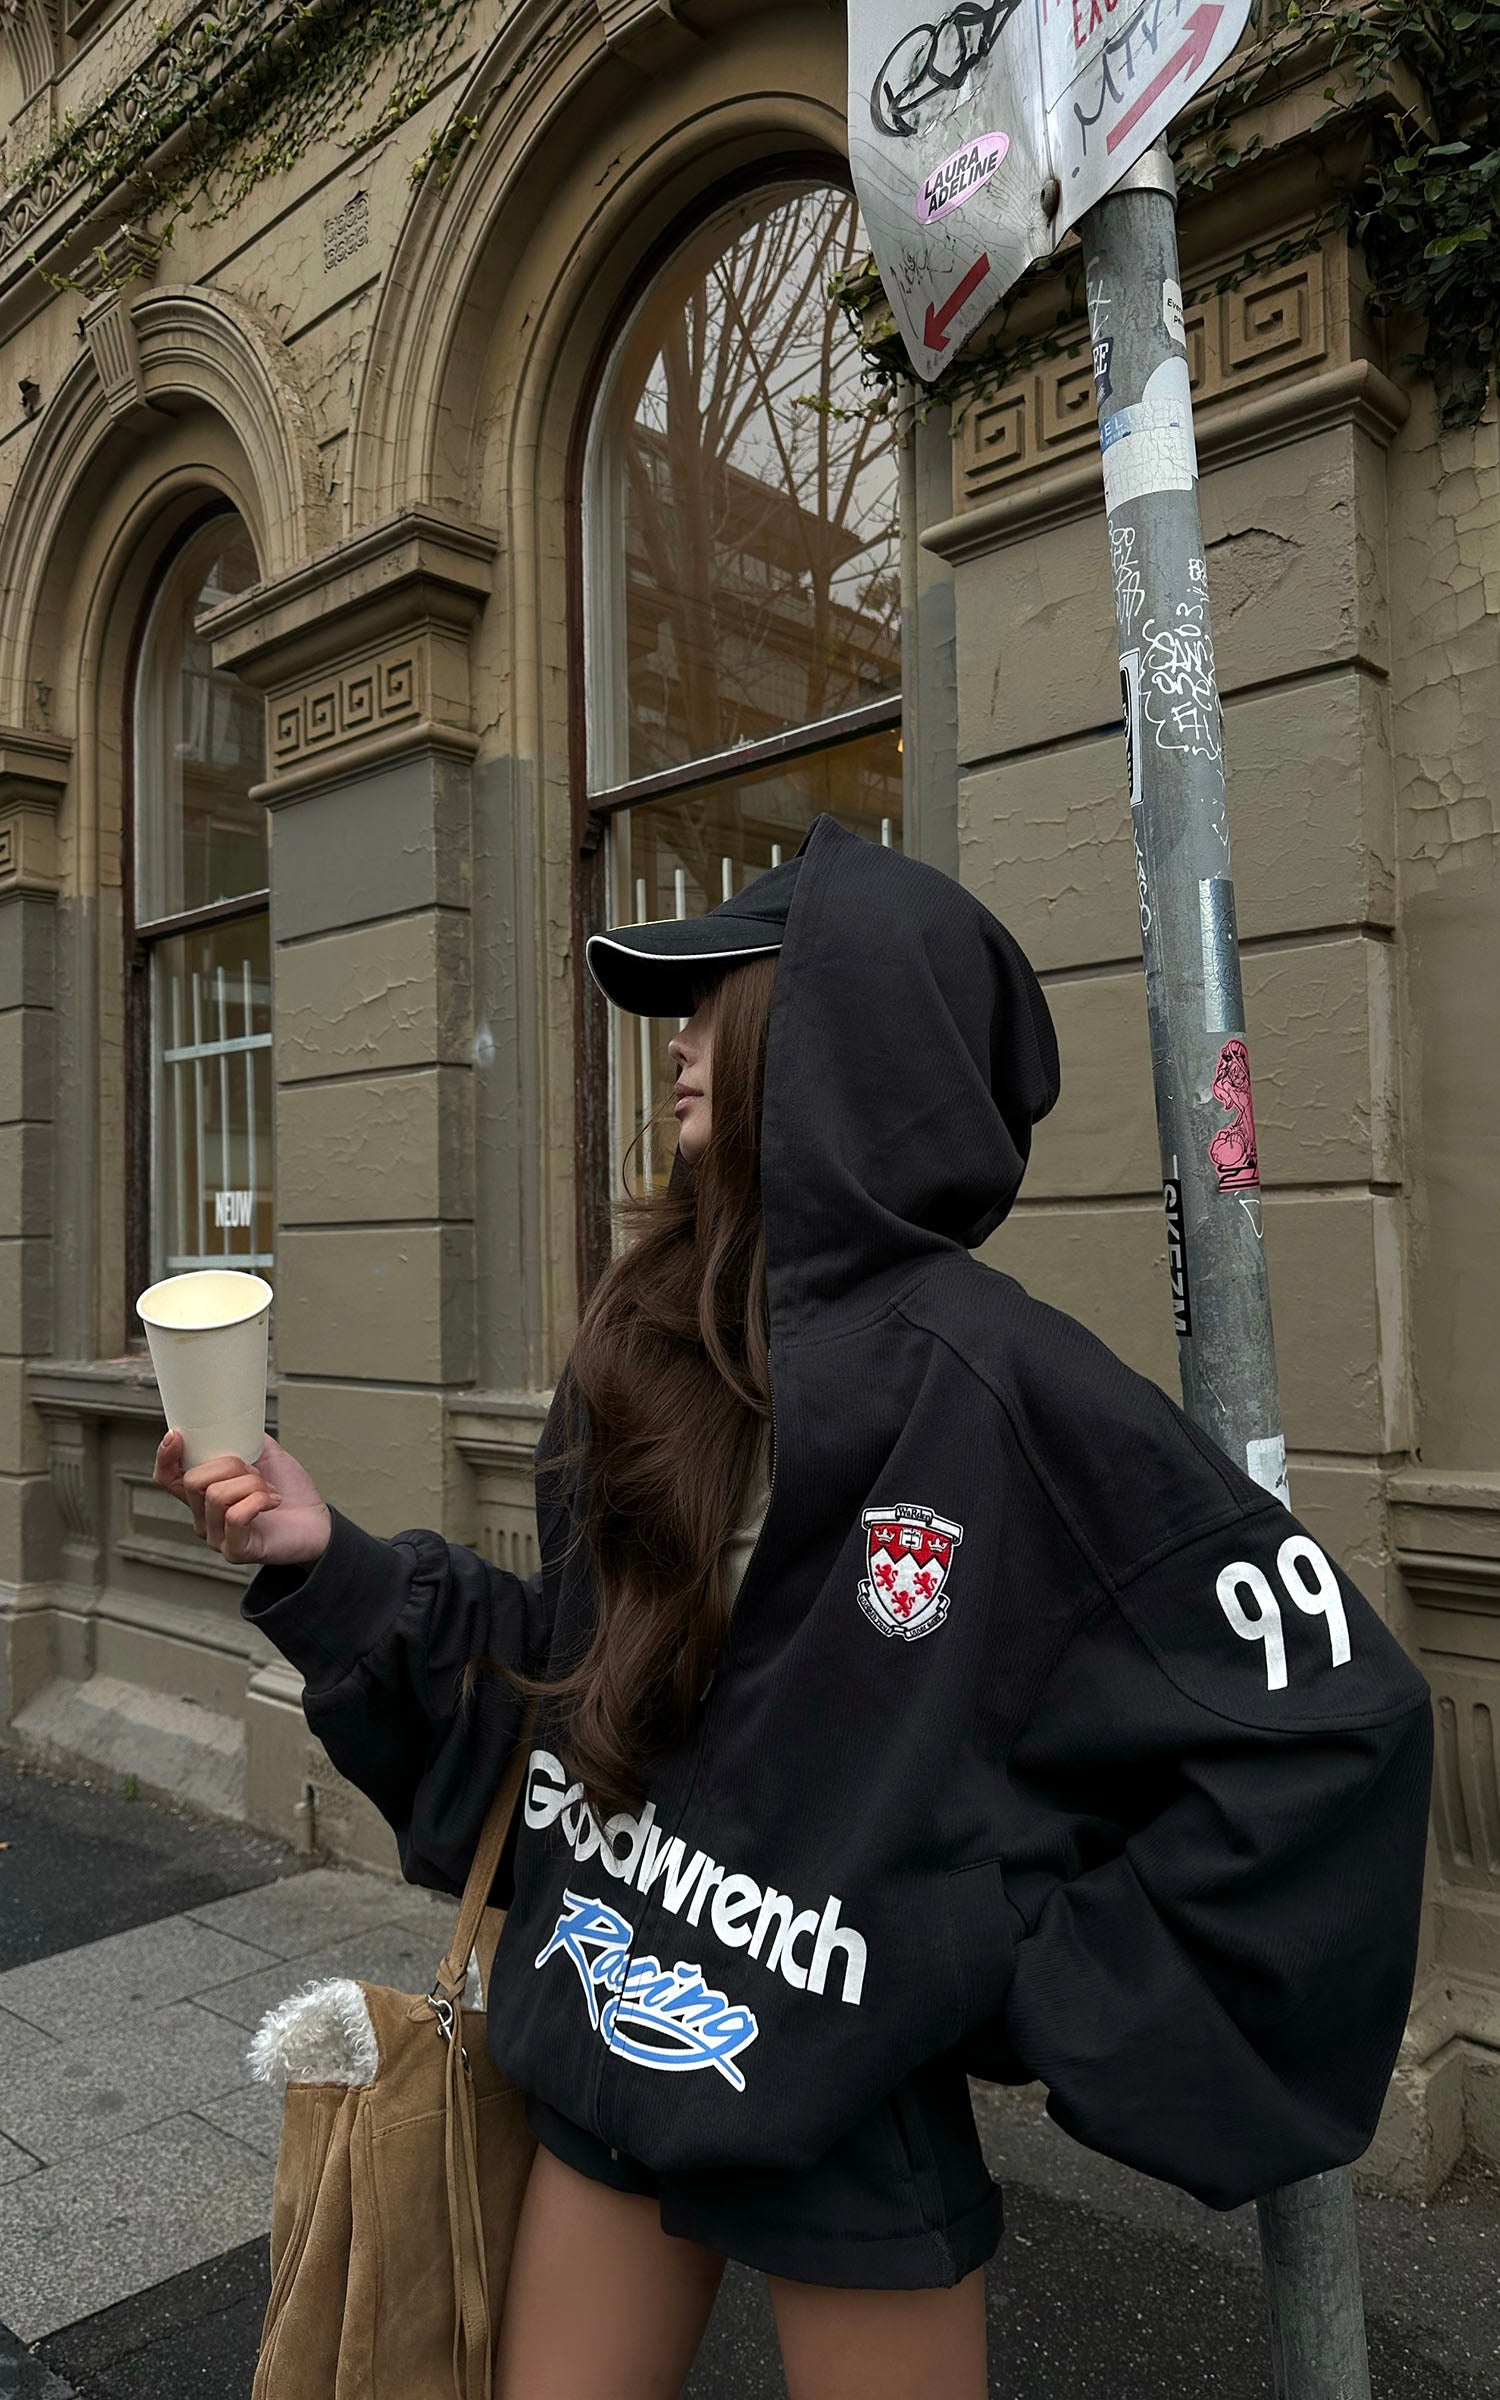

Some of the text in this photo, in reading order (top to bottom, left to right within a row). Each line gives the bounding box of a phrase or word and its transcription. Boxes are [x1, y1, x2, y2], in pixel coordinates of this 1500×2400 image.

[925, 146, 979, 200] LAURA
[928, 149, 999, 217] ADELINE
[215, 1190, 253, 1227] NEUW
[1215, 1535, 1351, 1691] 99
[524, 1749, 867, 2005] Goodwrench
[534, 1887, 759, 2092] Racing
